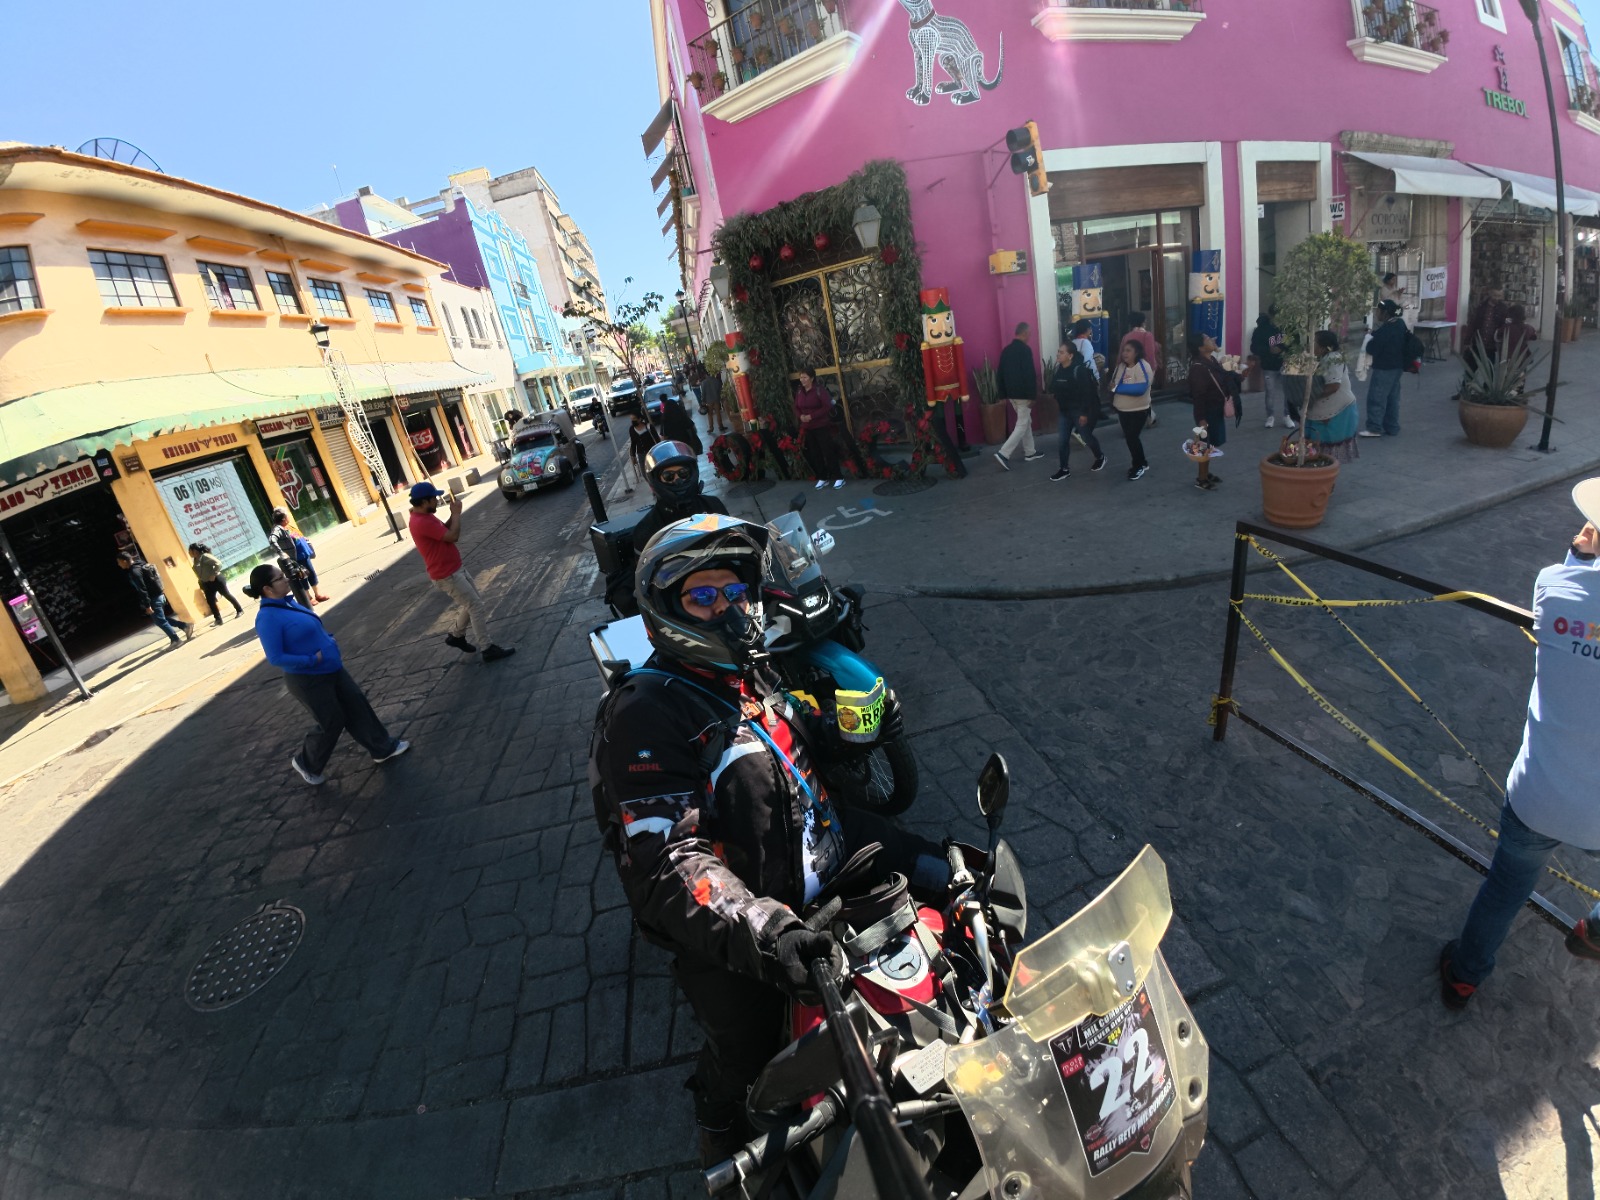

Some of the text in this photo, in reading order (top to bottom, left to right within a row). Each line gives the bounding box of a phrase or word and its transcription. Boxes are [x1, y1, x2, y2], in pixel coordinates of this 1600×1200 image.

[1482, 87, 1530, 118] TREBOL
[1371, 213, 1407, 225] CORONA
[1426, 271, 1445, 281] COMPRO
[1430, 280, 1443, 291] ORO
[173, 484, 190, 501] 06
[195, 478, 211, 494] 09
[193, 493, 229, 510] BANORTE
[659, 626, 712, 648] MT
[1083, 1023, 1099, 1040] MIL
[1089, 1026, 1111, 1046] NEVER
[1110, 1012, 1125, 1029] GIVE
[1123, 1004, 1132, 1015] UP
[1107, 1026, 1122, 1043] 2024
[1062, 1056, 1083, 1071] moto
[1066, 1060, 1083, 1074] rent
[1089, 1027, 1156, 1120] 22
[1093, 1138, 1117, 1161] RALLY
[1118, 1122, 1137, 1145] RETO
